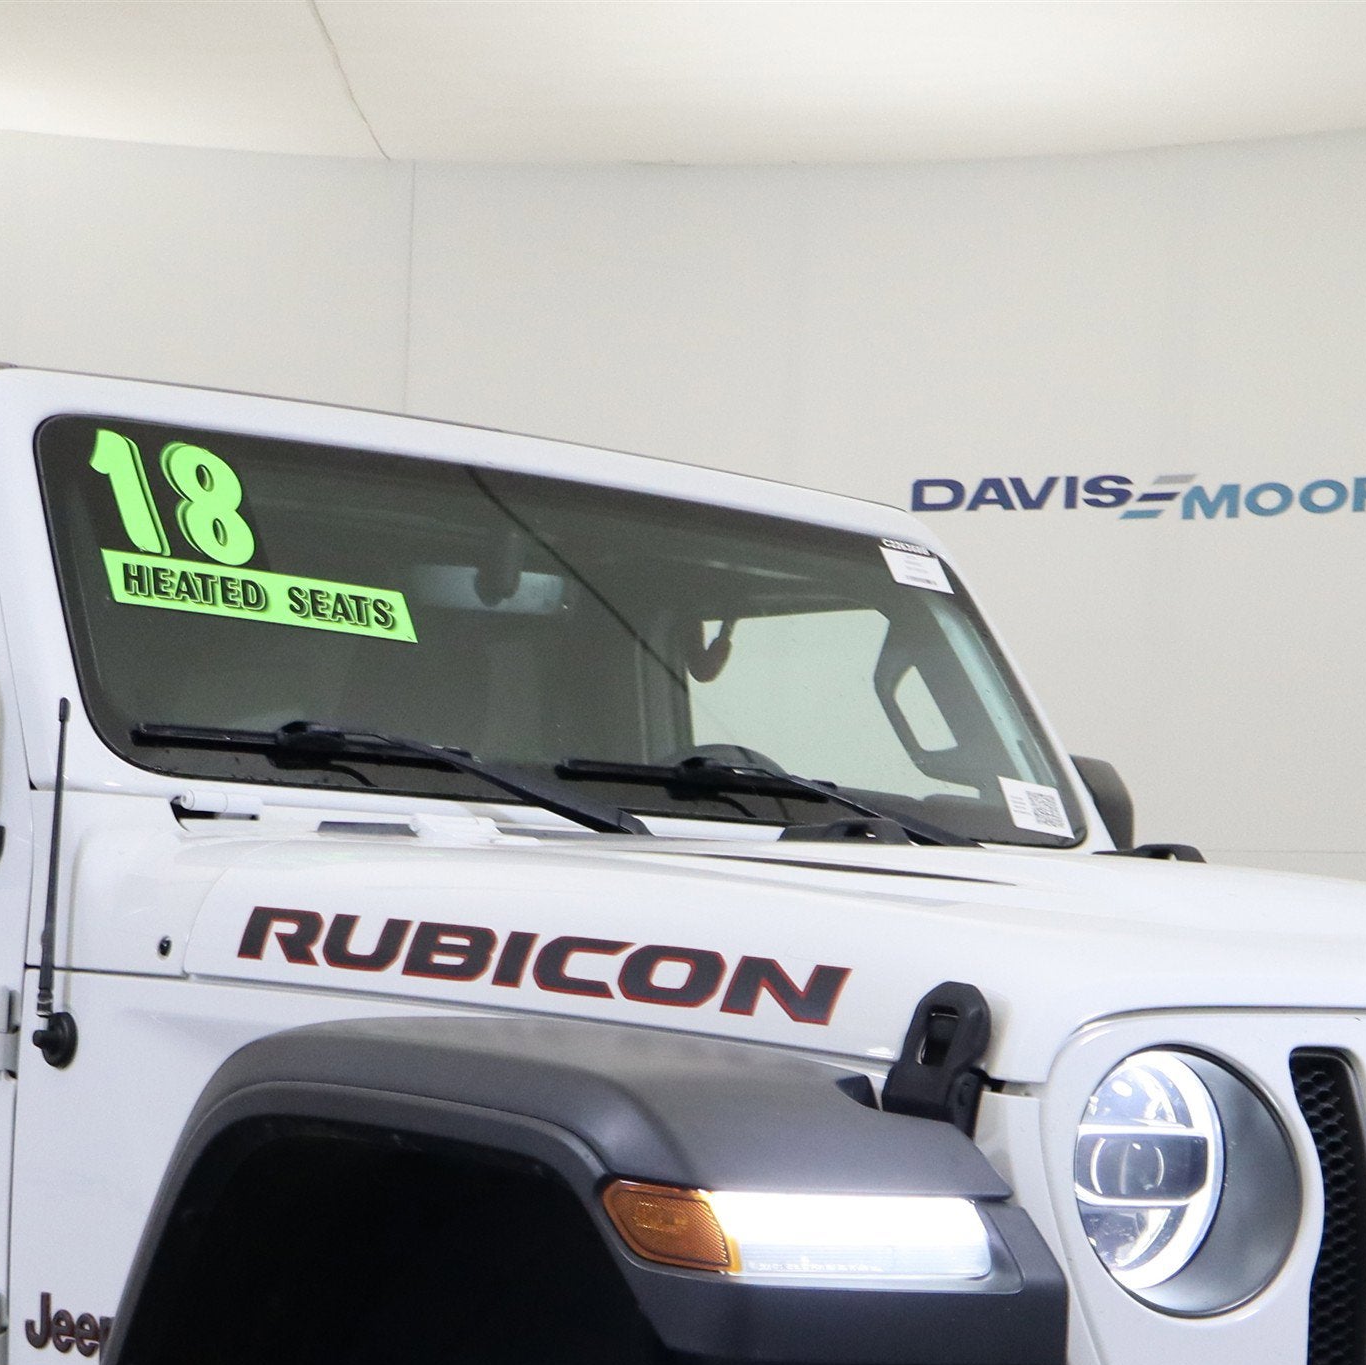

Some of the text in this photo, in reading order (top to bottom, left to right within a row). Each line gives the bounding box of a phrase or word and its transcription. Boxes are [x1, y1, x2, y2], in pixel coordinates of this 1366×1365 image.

[89, 428, 255, 566] 18
[911, 475, 1134, 512] DAVIS
[122, 562, 396, 629] HEATED SEATS
[237, 906, 853, 1027] RUBICON
